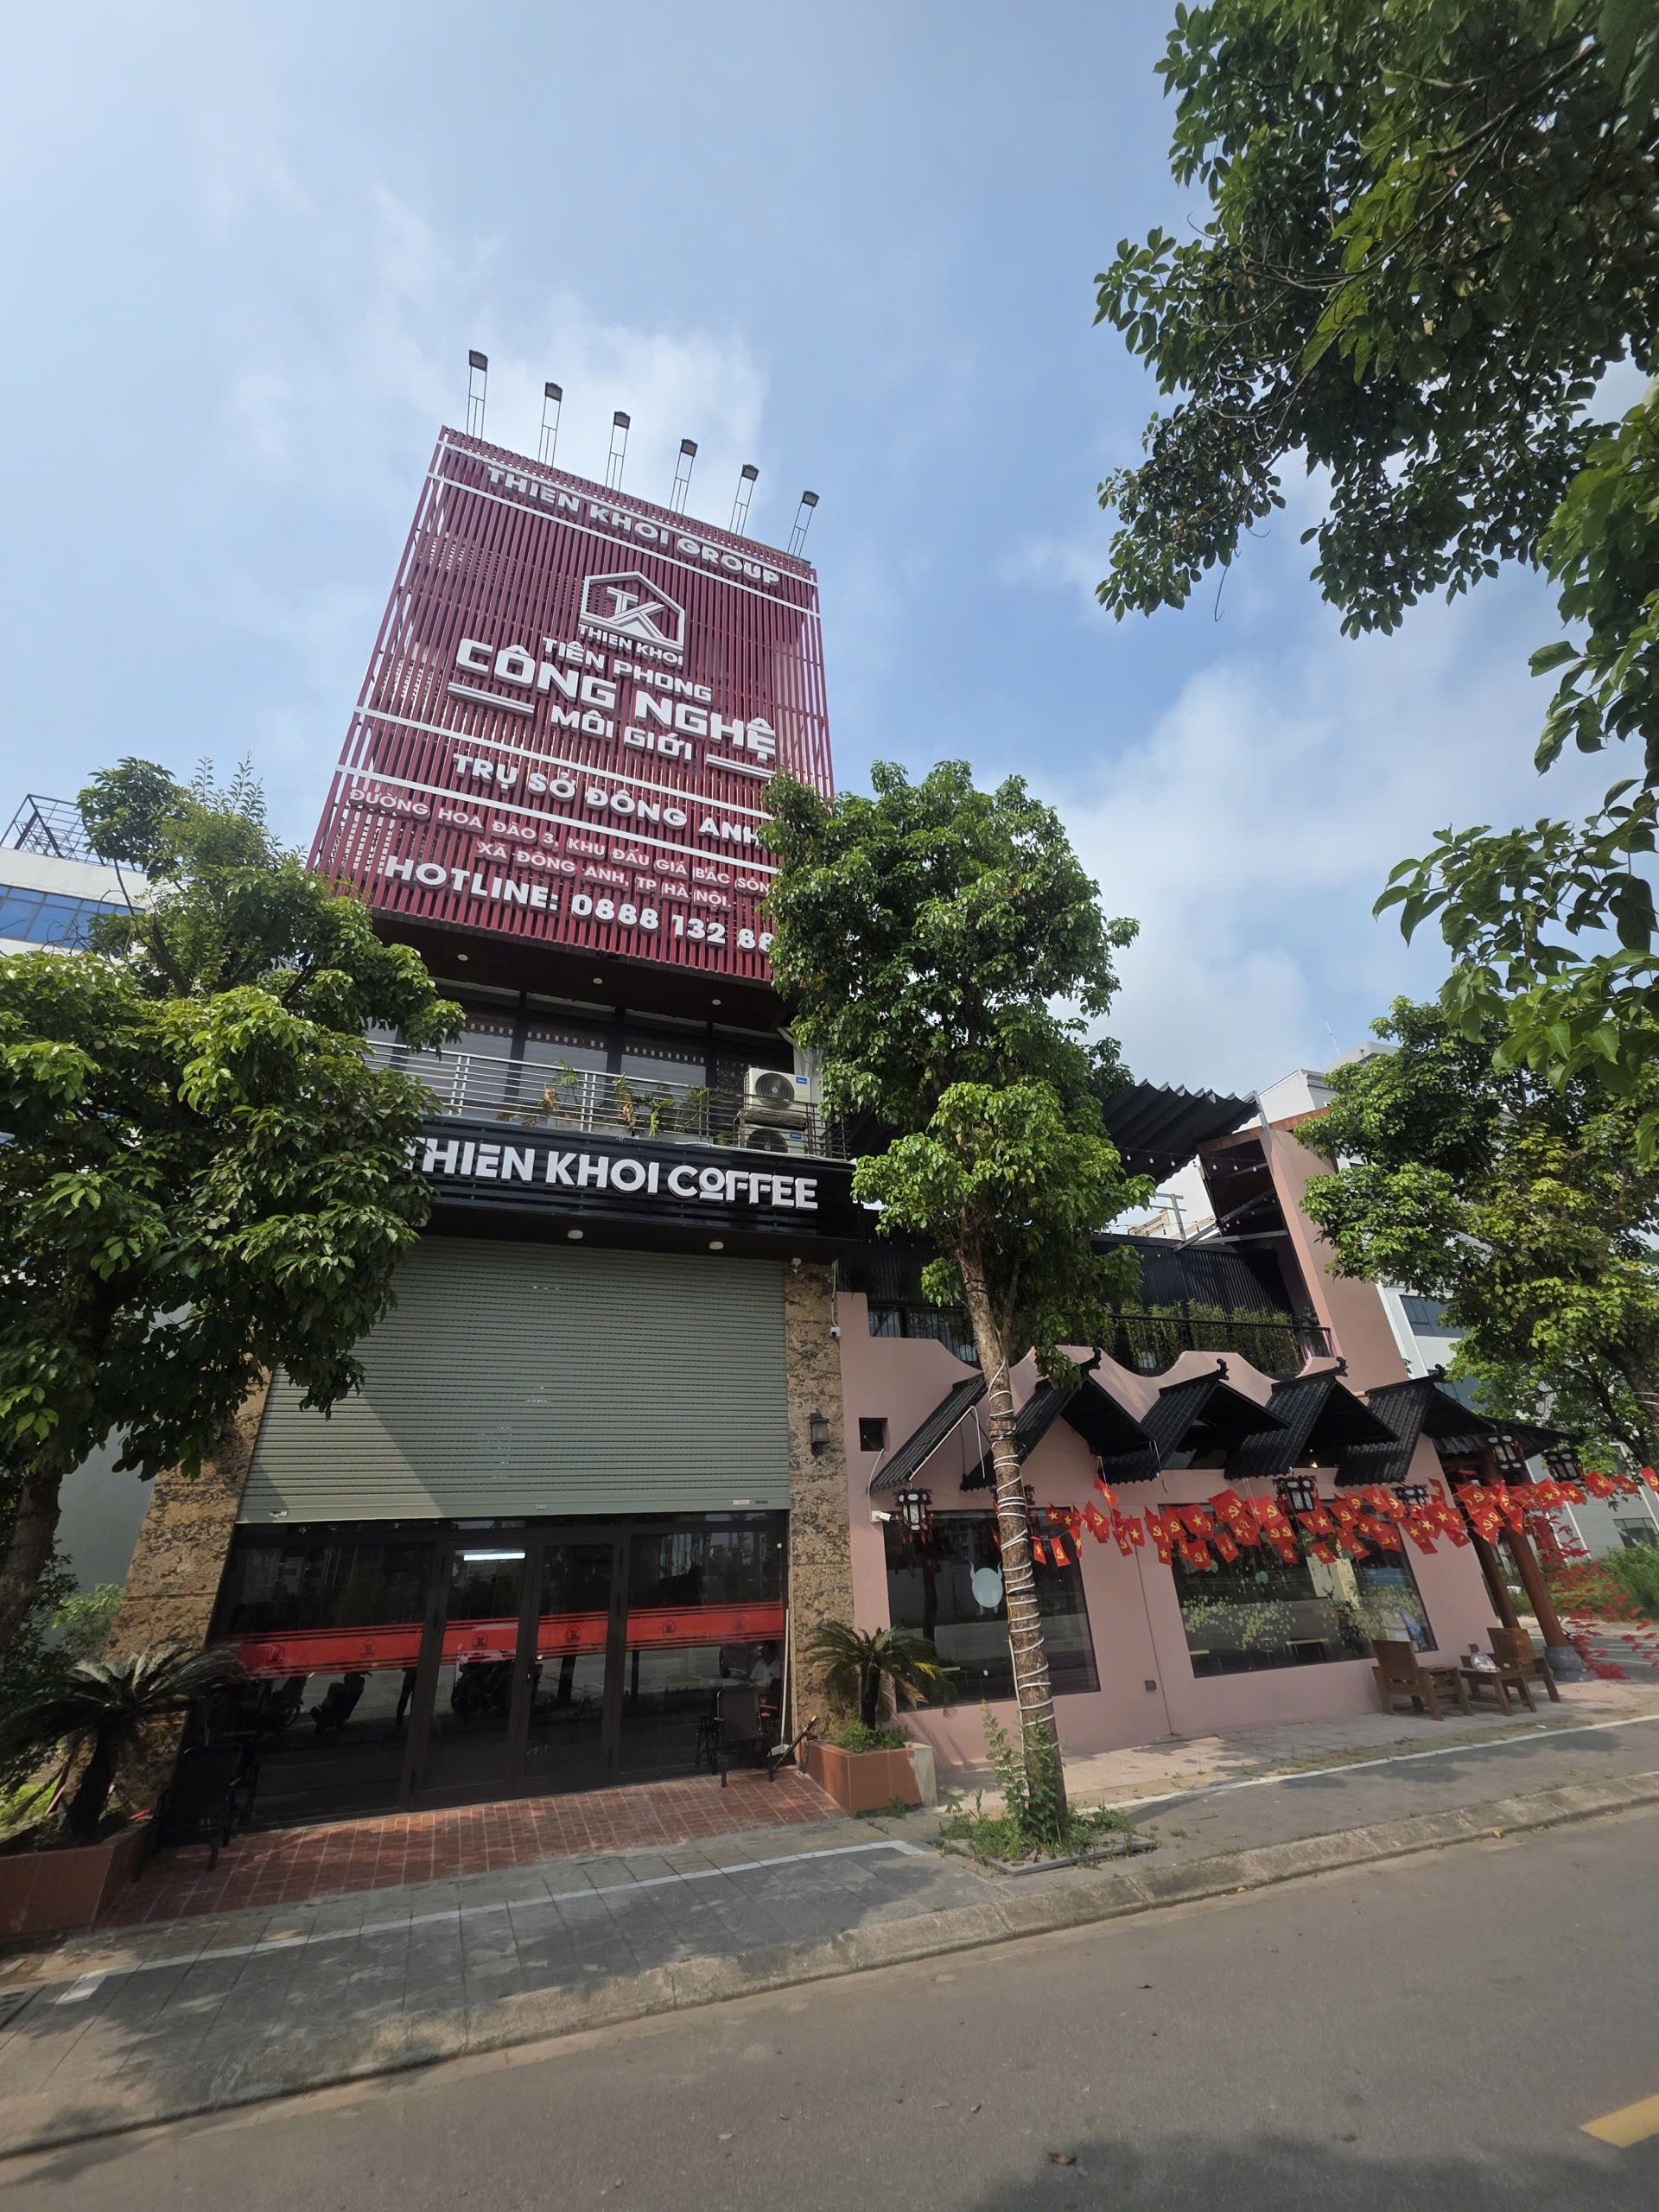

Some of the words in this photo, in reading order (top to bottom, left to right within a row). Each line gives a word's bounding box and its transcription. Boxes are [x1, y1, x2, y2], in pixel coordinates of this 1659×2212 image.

[487, 466, 580, 513] THIEN
[589, 503, 669, 546] KHOI
[677, 537, 779, 586] GROUP
[543, 636, 605, 671] TIÊN
[613, 659, 713, 703] PHONG
[578, 624, 632, 651] THIEN
[636, 643, 683, 666] KHOI
[456, 638, 616, 710] CÔNG
[635, 691, 776, 762] NGHỆ
[550, 704, 614, 739] MÔI
[624, 726, 692, 761] GIỚI
[349, 788, 429, 816] ĐƯỜNG
[437, 808, 483, 830] HOA
[492, 820, 537, 839] ĐÀO
[543, 831, 558, 848] 3,
[567, 837, 605, 856] KHU
[612, 848, 650, 866] ĐẤU
[656, 858, 688, 875] GIÁ
[695, 866, 730, 884] BẮC
[453, 753, 518, 790] TRỤ
[528, 772, 576, 798] SỞ
[585, 786, 688, 827] ĐÔNG
[698, 817, 760, 847] ANH
[385, 855, 559, 911] HOTLINE:
[571, 893, 659, 931] 0888
[671, 914, 726, 945] 132
[738, 928, 774, 953] 88
[477, 841, 507, 859] XÃ
[516, 849, 576, 873] ĐÔNG
[584, 865, 629, 887] ANH,
[637, 876, 657, 890] TP
[664, 883, 690, 898] HÀ
[546, 1150, 660, 1195] KHOI
[668, 1166, 818, 1210] COFFEE
